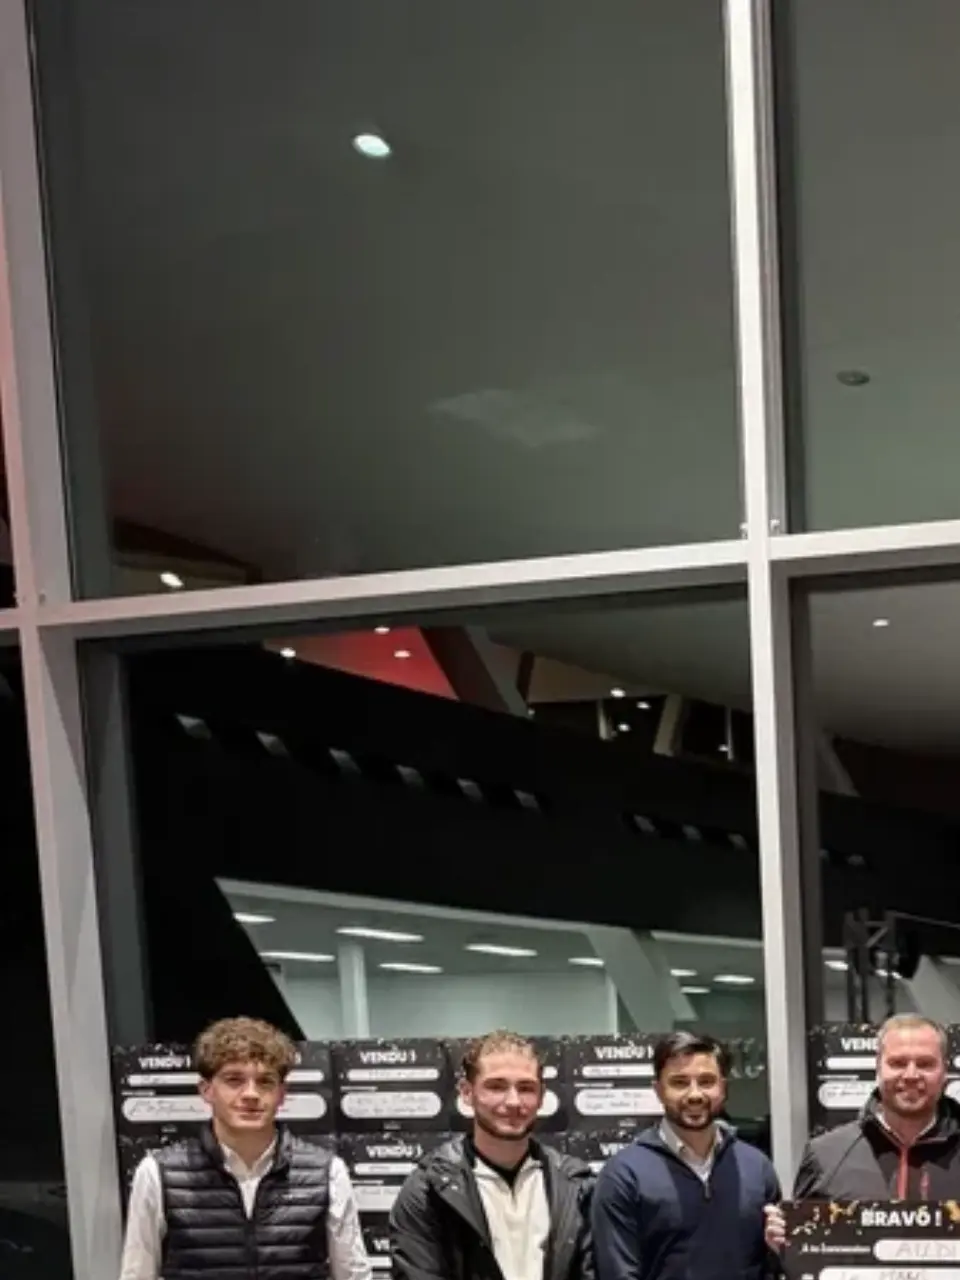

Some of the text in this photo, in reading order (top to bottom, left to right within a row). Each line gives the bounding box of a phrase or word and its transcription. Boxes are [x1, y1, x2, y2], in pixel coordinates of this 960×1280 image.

[360, 1049, 407, 1064] VENDU
[594, 1045, 645, 1059] VENDU
[861, 1207, 930, 1227] BRAVO
